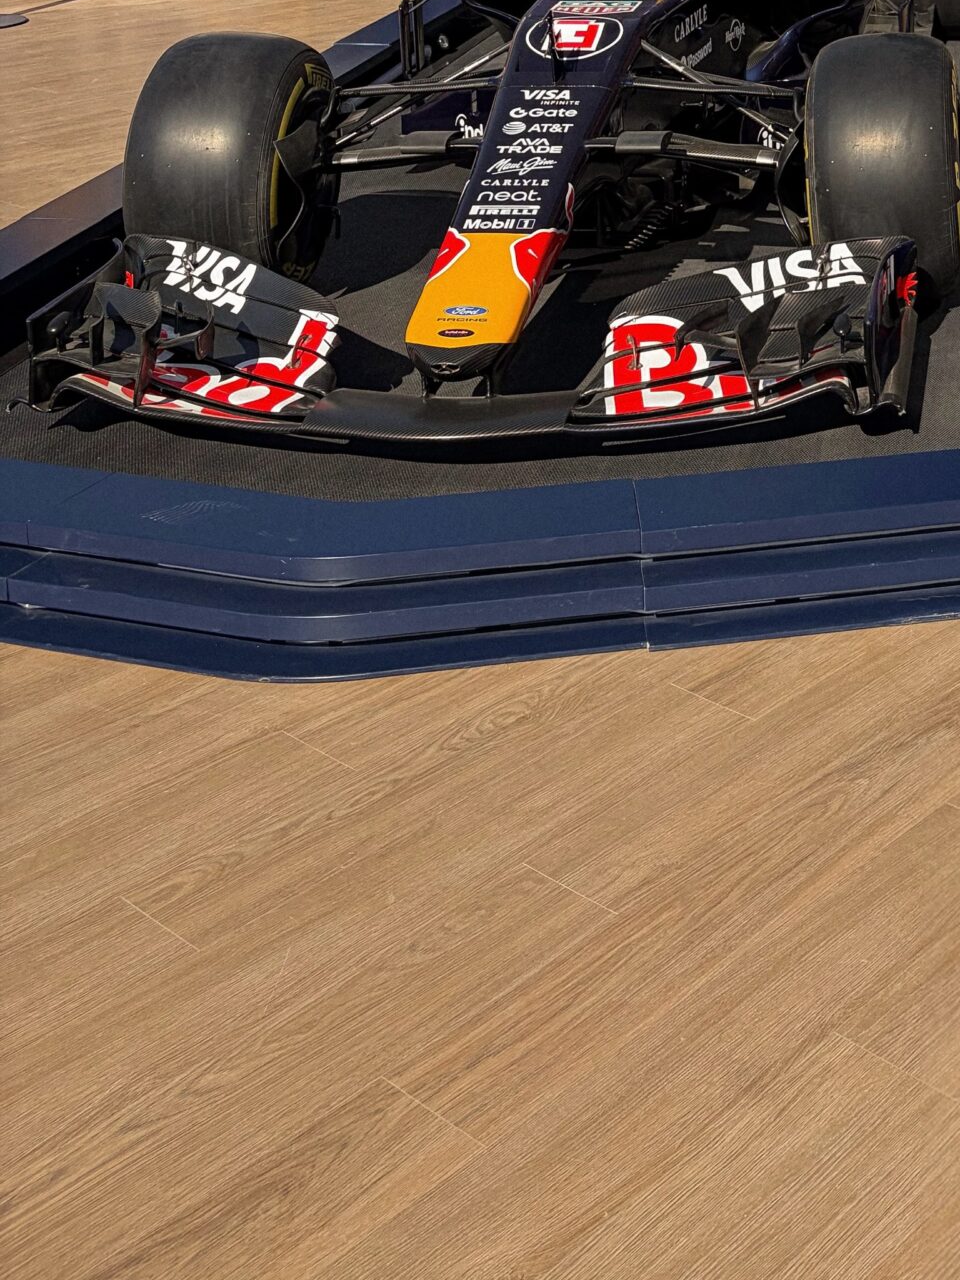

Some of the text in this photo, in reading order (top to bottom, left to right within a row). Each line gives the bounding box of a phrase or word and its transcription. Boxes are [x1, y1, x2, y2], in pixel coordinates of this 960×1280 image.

[674, 4, 708, 43] CARLYLE
[520, 90, 571, 100] VISA
[527, 123, 574, 133] AT&T
[512, 138, 550, 146] AVA
[496, 146, 563, 154] TRADE
[476, 189, 542, 201] neat.
[469, 204, 541, 216] PIRELLI
[463, 218, 515, 229] Mobil
[163, 239, 257, 315] VISA
[712, 242, 867, 313] VISA
